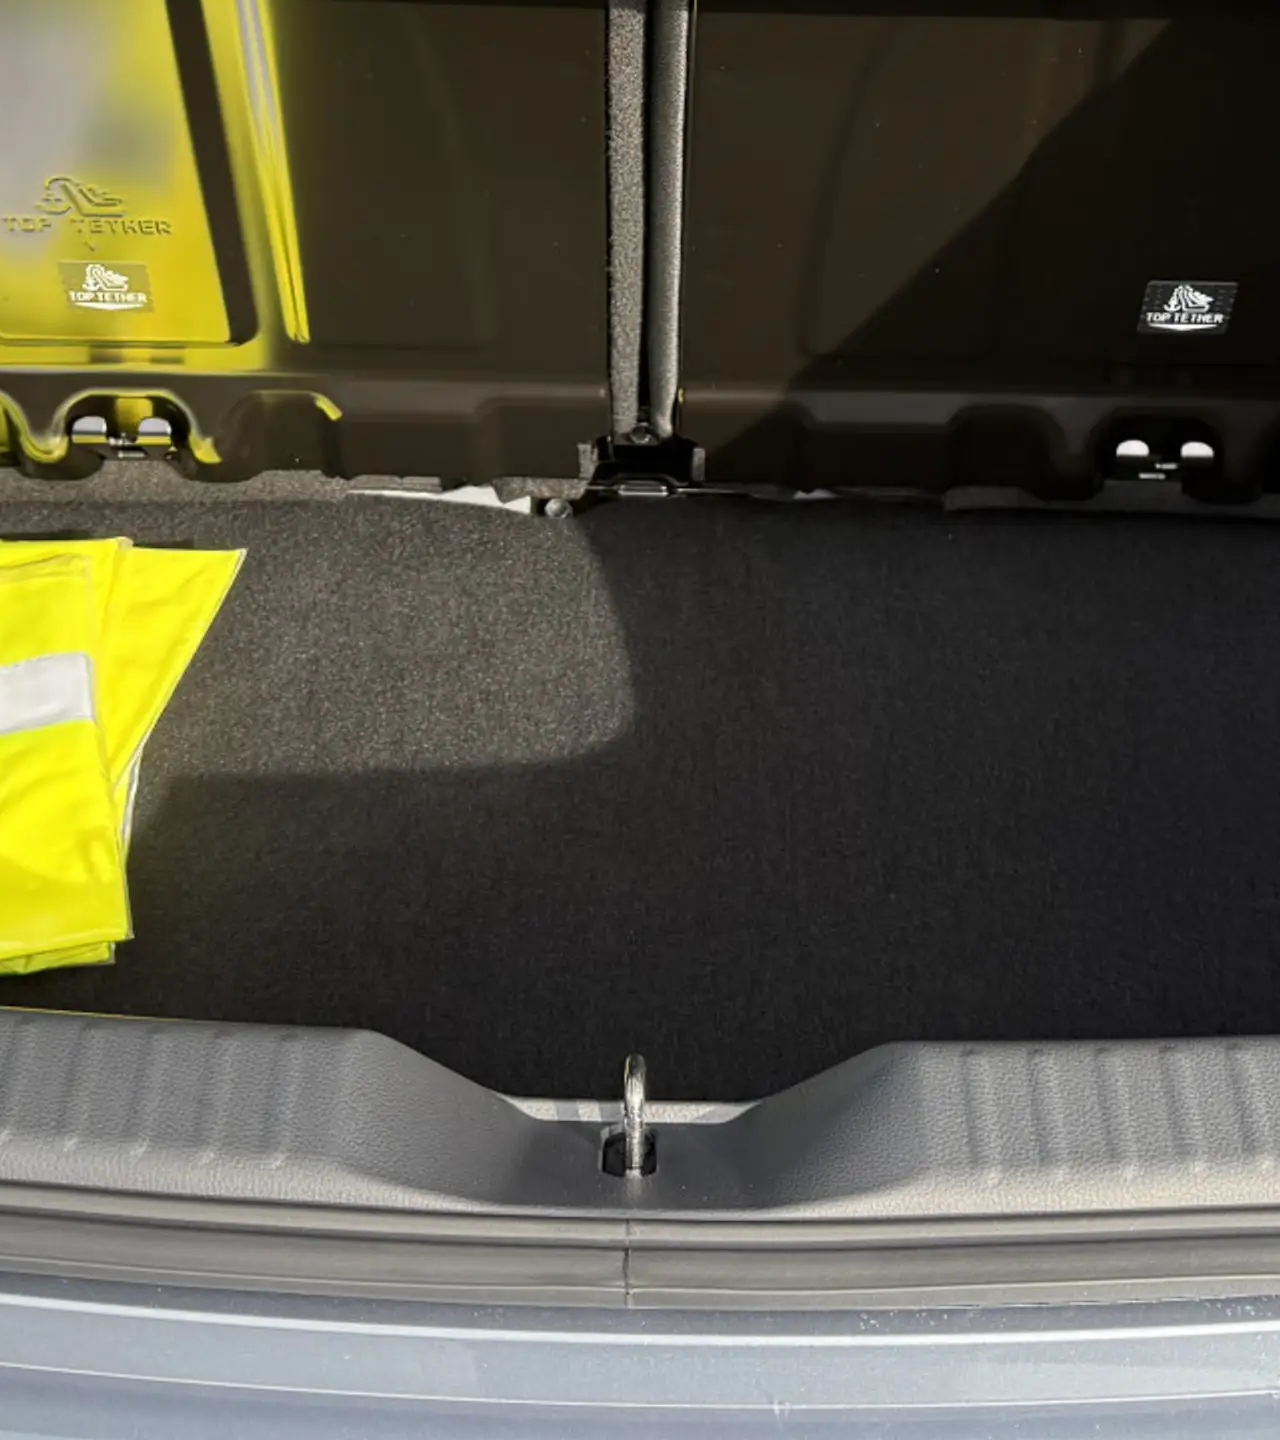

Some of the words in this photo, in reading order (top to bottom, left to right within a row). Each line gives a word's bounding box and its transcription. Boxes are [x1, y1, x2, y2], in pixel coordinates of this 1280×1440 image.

[2, 216, 52, 233] TOP
[70, 216, 173, 236] TETHER
[68, 290, 95, 302] TOP
[96, 291, 148, 303] TETHER
[1146, 312, 1172, 322] TOP
[1174, 312, 1224, 324] TETHER
